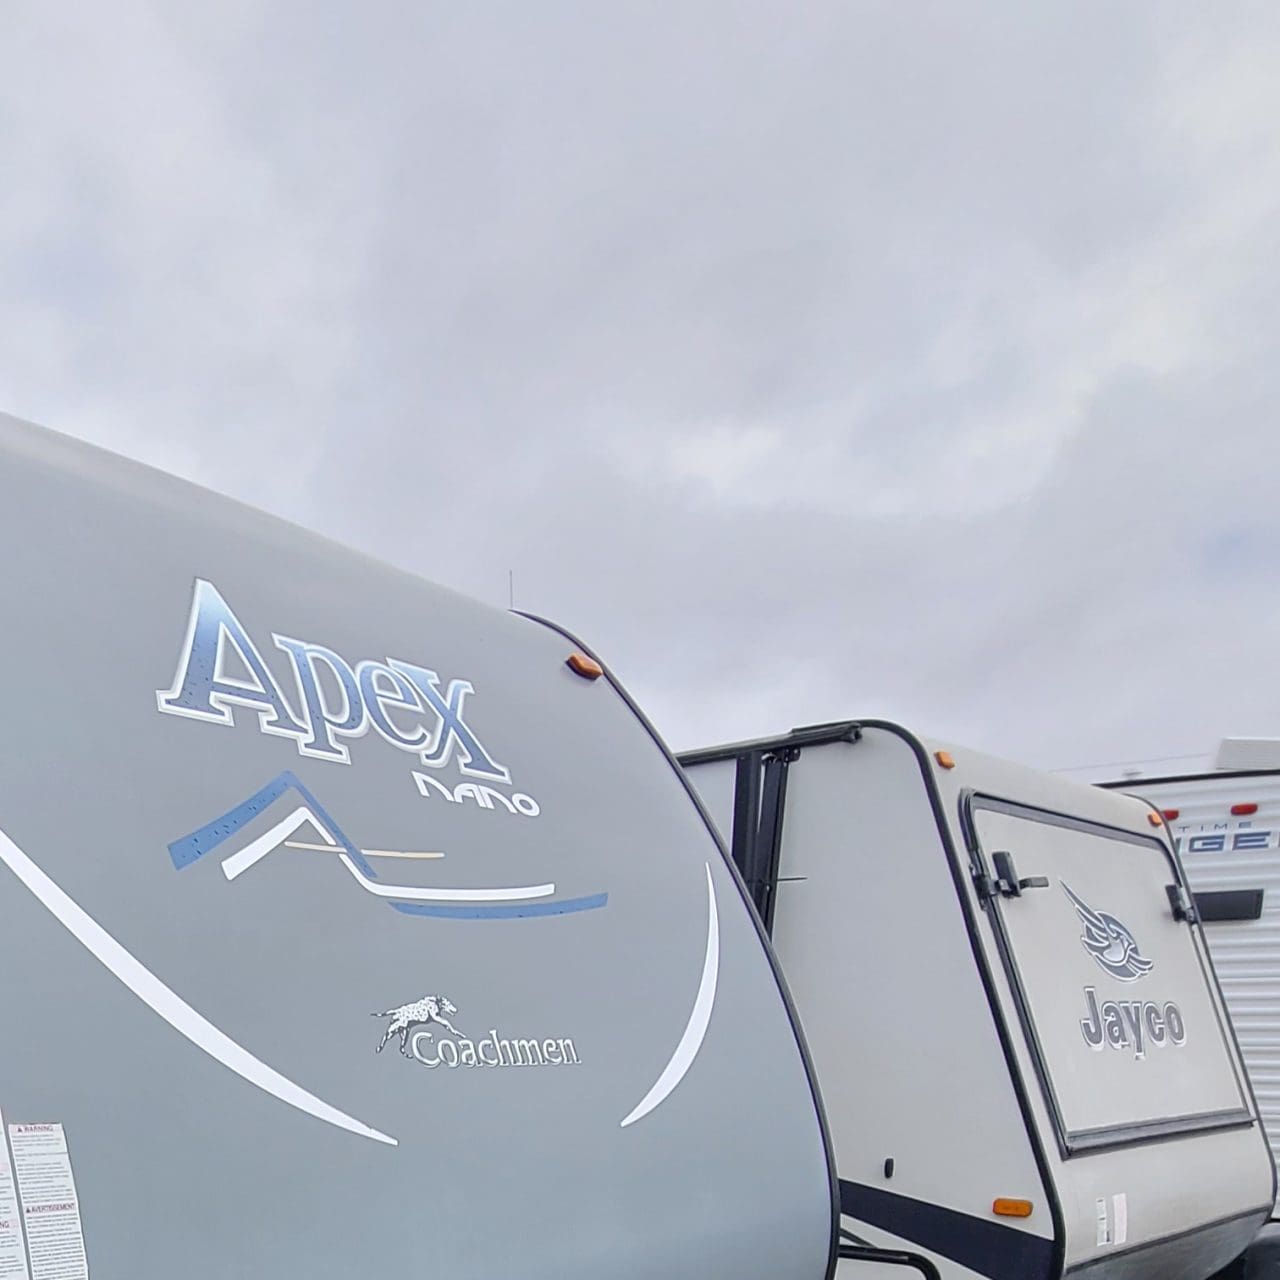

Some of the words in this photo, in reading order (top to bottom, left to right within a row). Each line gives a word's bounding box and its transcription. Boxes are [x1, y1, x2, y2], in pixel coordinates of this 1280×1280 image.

[156, 576, 512, 784] Apex
[410, 1030, 582, 1068] Coachmen
[1080, 986, 1187, 1061] Jayco
[24, 1124, 53, 1132] WARNING
